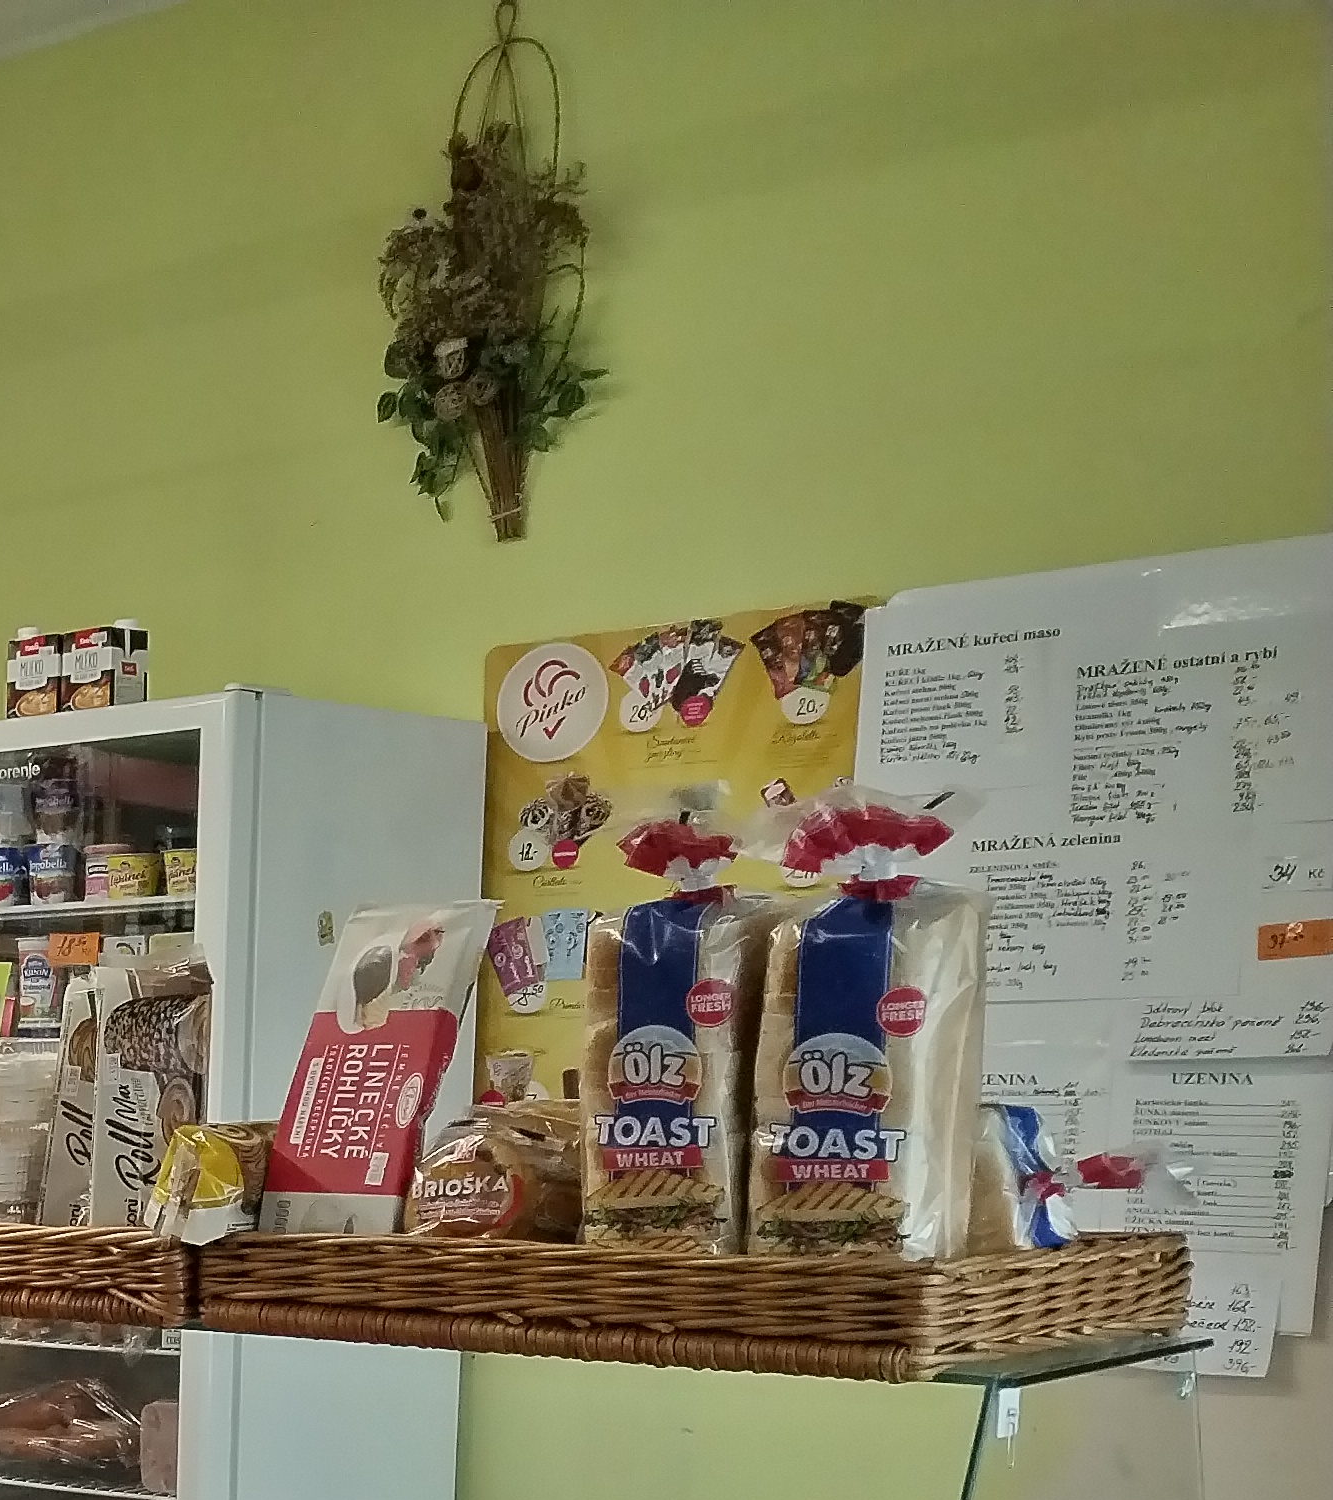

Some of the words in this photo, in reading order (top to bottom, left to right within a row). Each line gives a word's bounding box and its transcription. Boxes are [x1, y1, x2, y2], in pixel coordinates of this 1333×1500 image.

[887, 632, 971, 658] MRAŽENÉ
[1023, 626, 1062, 642] maso
[1075, 653, 1169, 679] MRAŽENÉ
[516, 685, 587, 738] Pinko
[1060, 833, 1122, 848] zelenina
[690, 1002, 732, 1013] FRESH
[624, 1043, 686, 1087] Ölz
[799, 1050, 875, 1099] Ölz
[1171, 1071, 1255, 1087] UZENINA
[595, 1115, 716, 1148] TOAST
[770, 1123, 907, 1162] TOAST
[616, 1151, 684, 1168] WHEAT
[791, 1164, 871, 1181] WHEAT
